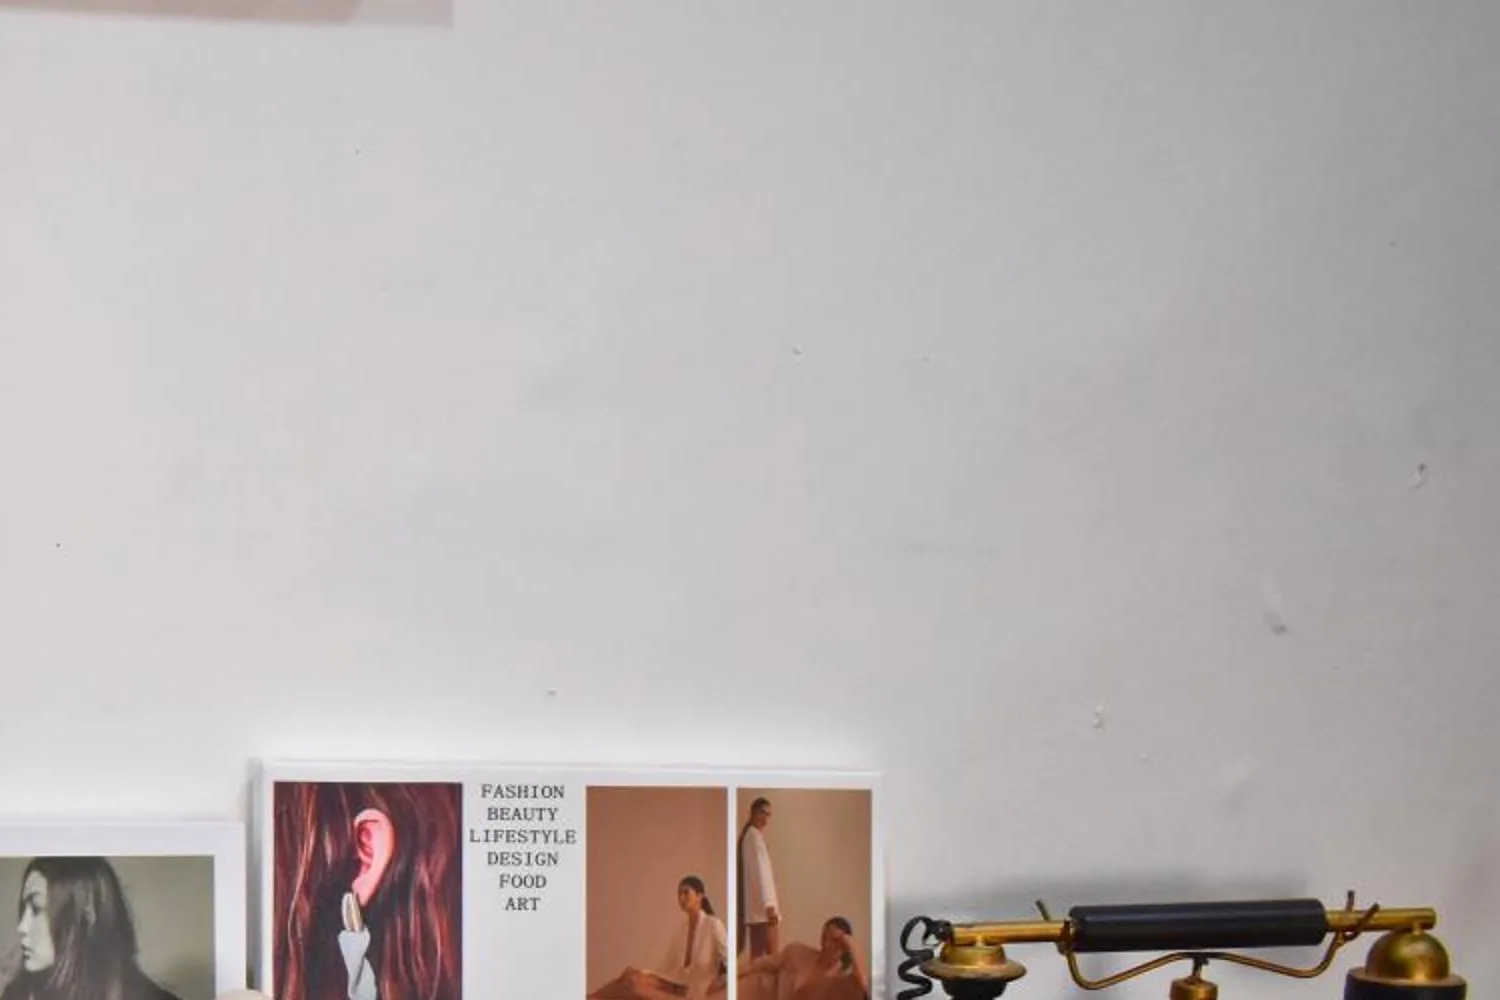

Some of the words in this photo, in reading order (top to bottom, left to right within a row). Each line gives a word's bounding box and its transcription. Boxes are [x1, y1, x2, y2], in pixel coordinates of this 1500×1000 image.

[481, 784, 564, 799] FASHION
[487, 807, 558, 821] BEAUTY
[469, 829, 577, 845] LIFESTYLE
[487, 851, 558, 866] DESIGN
[499, 874, 547, 889] FOOD
[505, 897, 541, 911] ART
